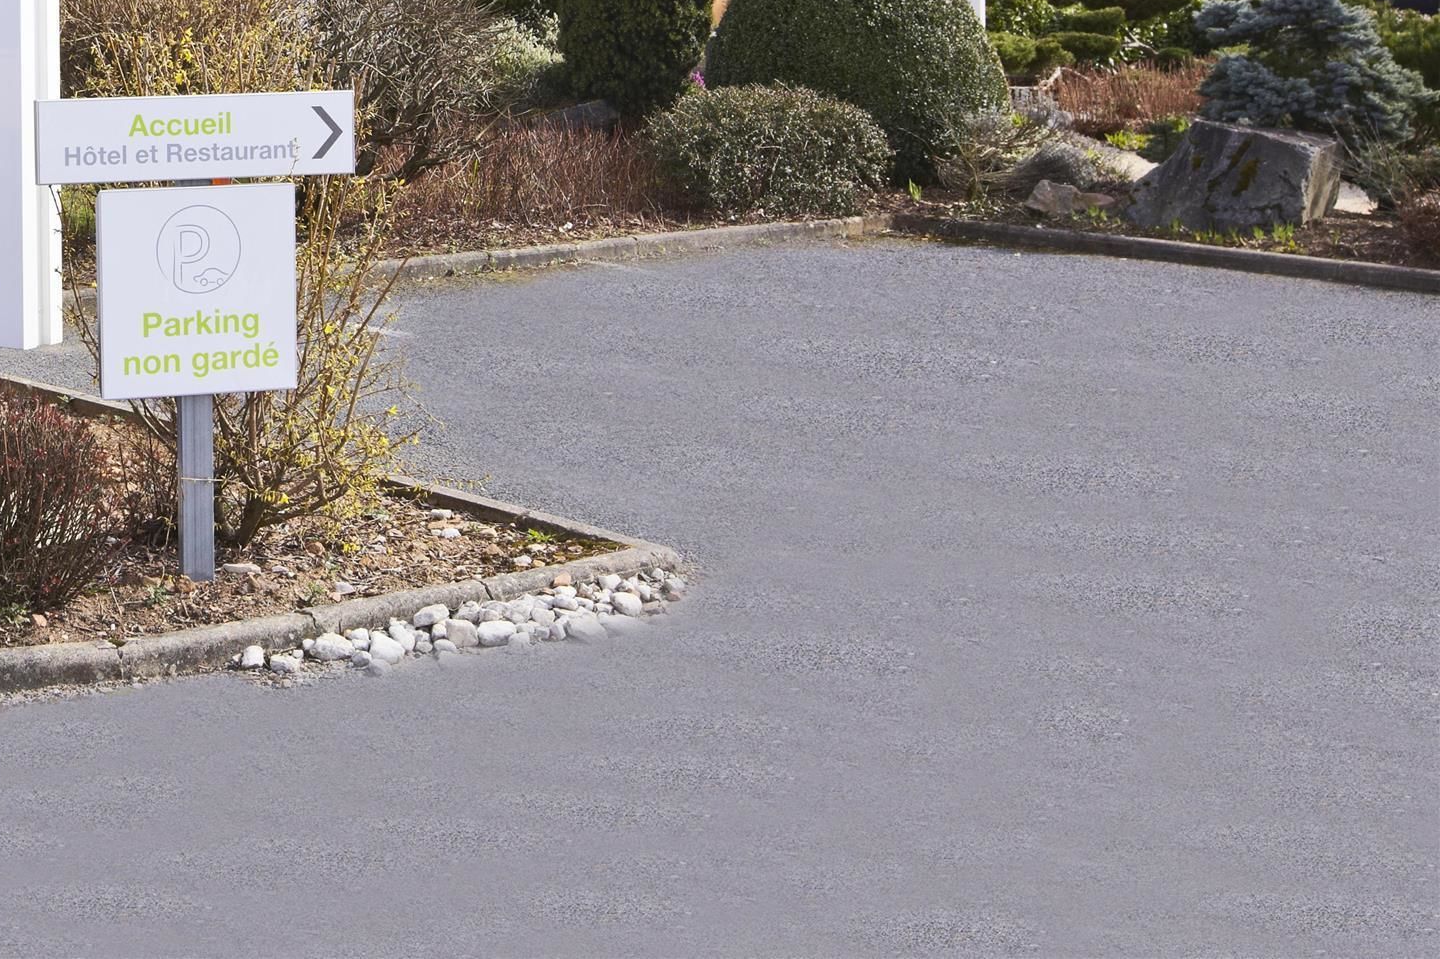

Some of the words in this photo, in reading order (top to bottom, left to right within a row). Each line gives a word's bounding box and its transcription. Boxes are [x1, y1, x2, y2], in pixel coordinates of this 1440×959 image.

[128, 112, 232, 137] Accueil
[64, 144, 128, 167] Hôtel
[135, 145, 158, 164] et
[166, 140, 297, 164] Restaurant
[142, 309, 260, 338] Parking
[123, 352, 181, 376] non
[191, 341, 280, 378] gardé
